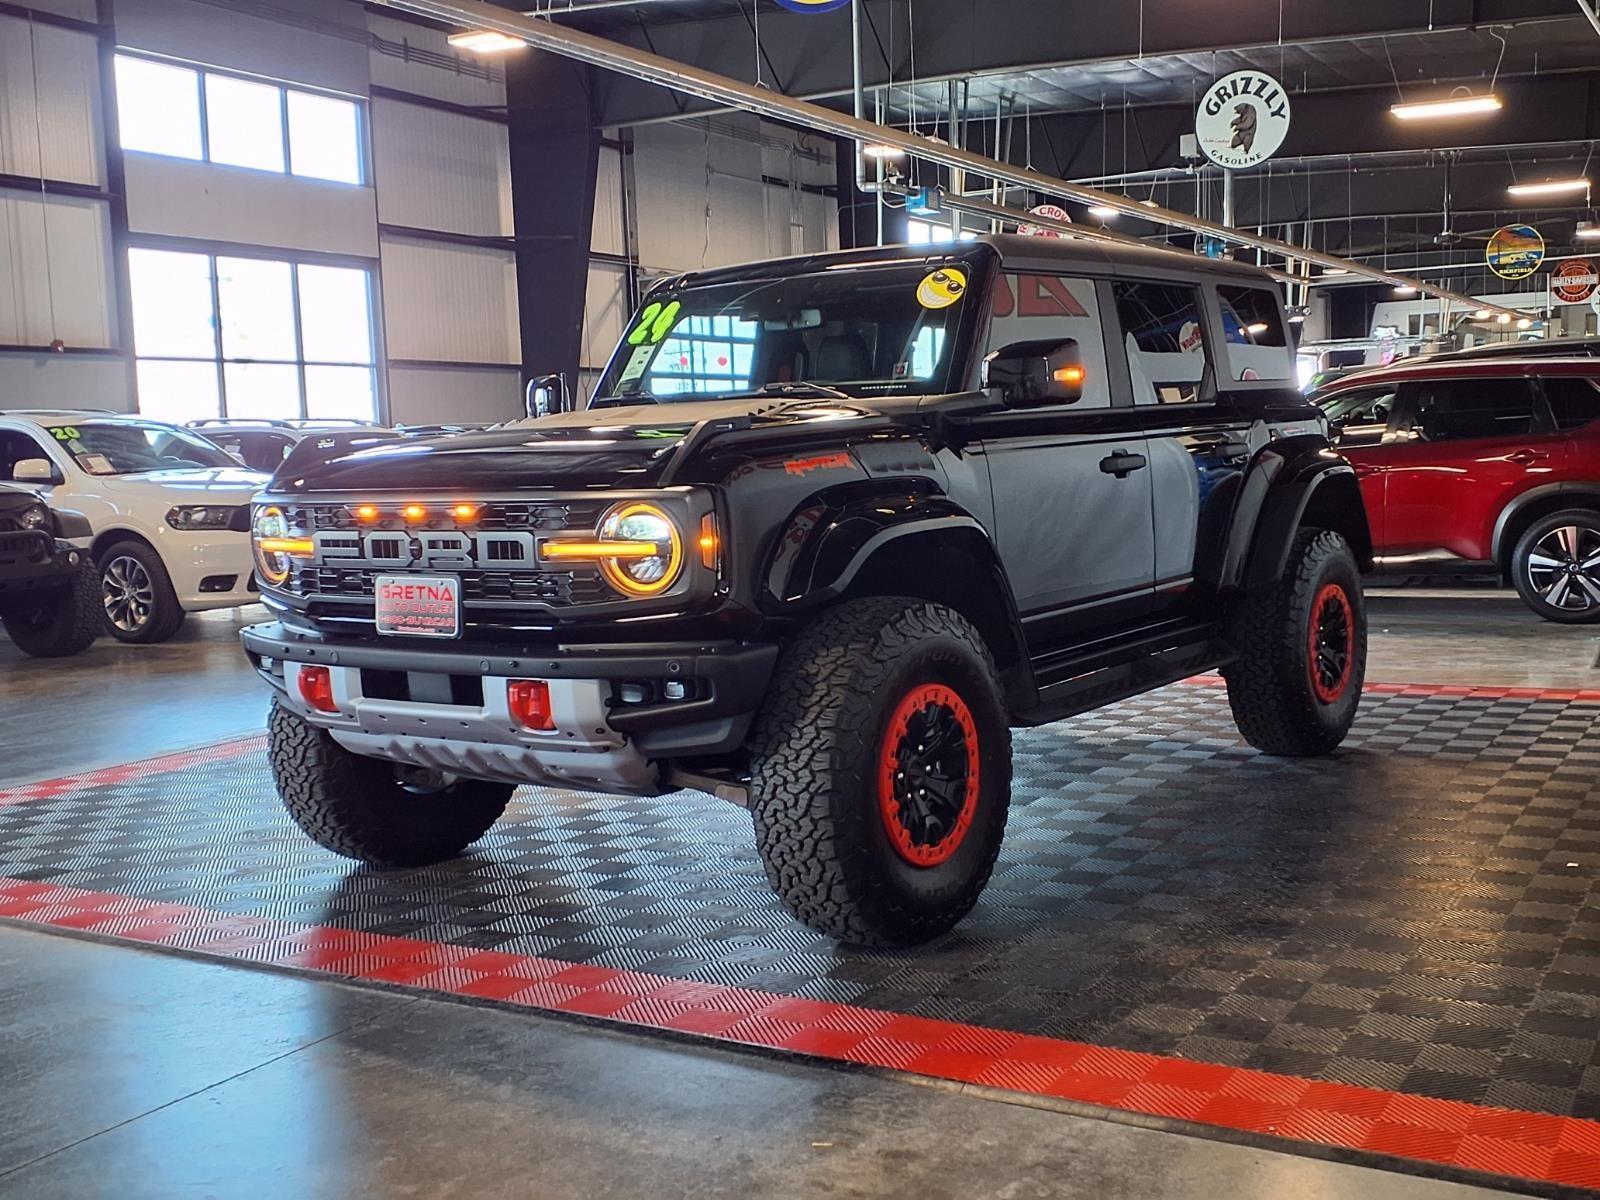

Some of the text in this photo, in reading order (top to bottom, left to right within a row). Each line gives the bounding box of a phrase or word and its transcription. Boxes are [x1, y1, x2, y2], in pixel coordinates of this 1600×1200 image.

[1205, 76, 1287, 120] GRIZZLY
[1210, 149, 1263, 165] GASOLINE
[627, 300, 681, 345] 24
[50, 426, 81, 440] 20
[312, 530, 536, 569] FORD
[381, 585, 454, 601] GRETNA
[381, 602, 455, 614] AUTO OUTLET
